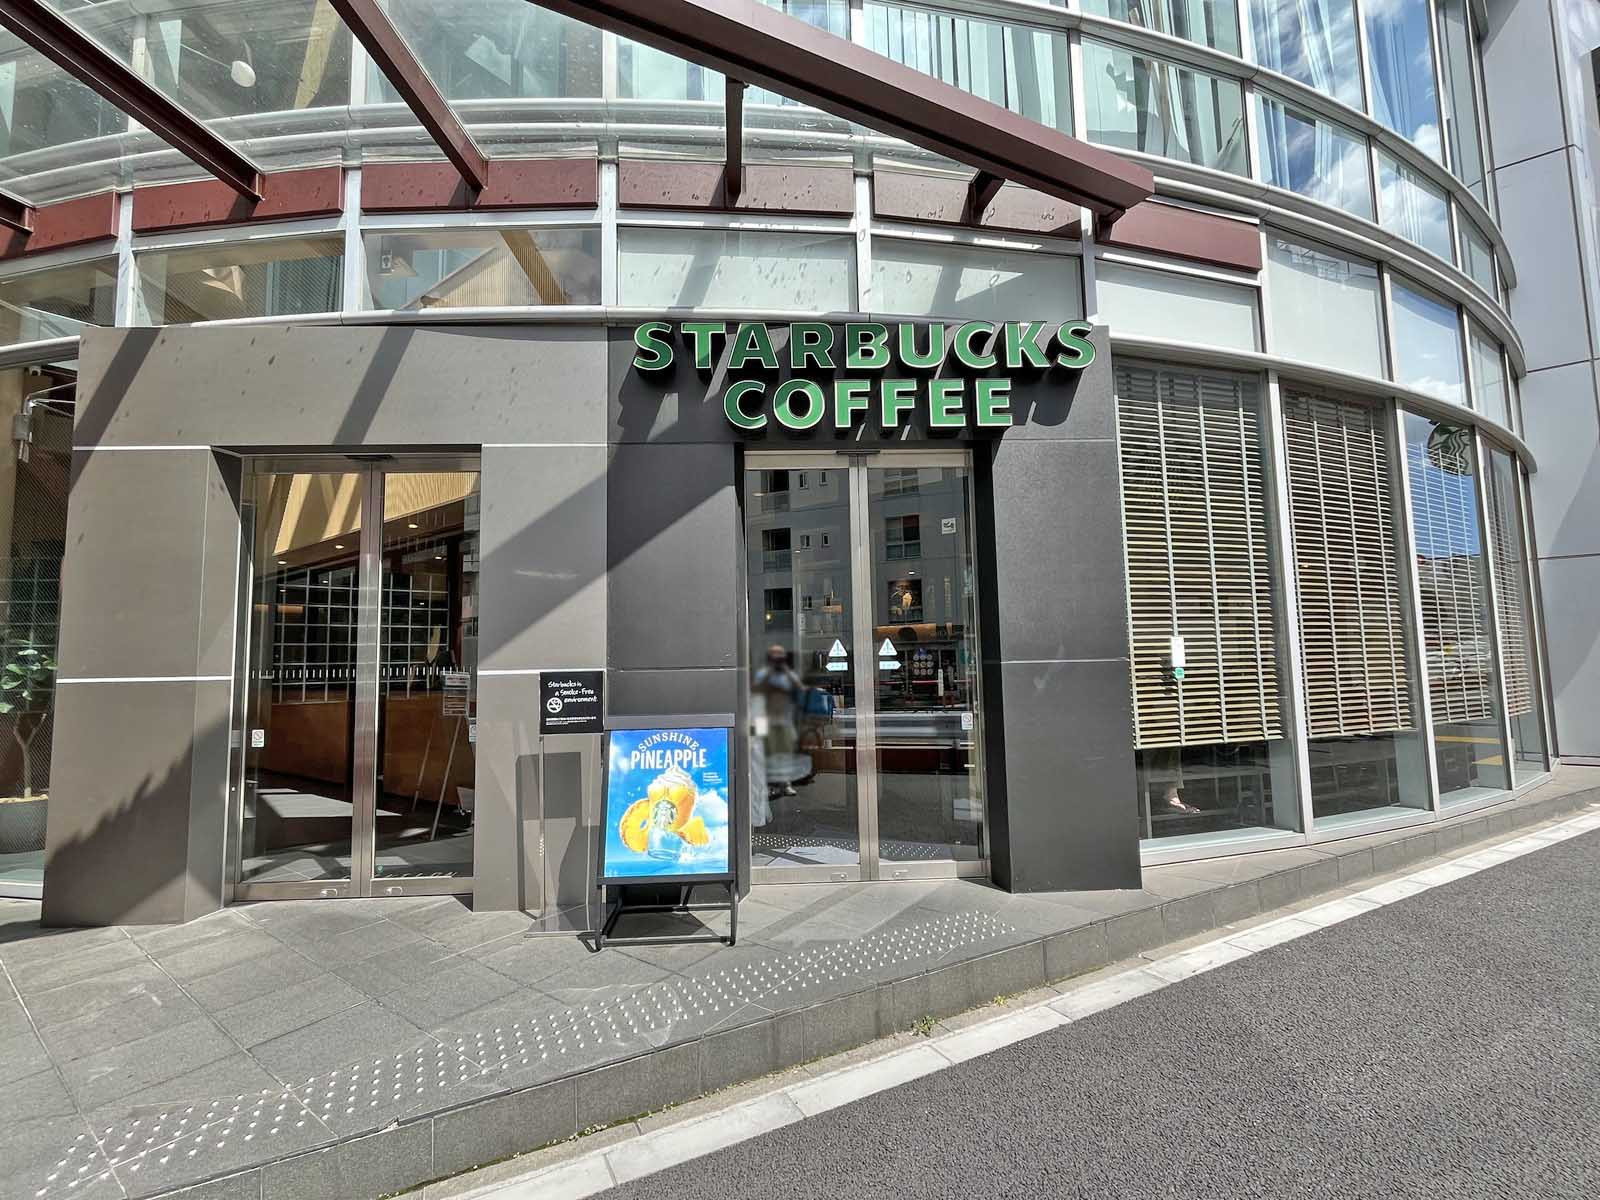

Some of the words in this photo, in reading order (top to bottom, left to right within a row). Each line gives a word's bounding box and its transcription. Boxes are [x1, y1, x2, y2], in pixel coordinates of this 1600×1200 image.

[633, 320, 1096, 371] STARBUCKS
[723, 377, 1013, 429] COFFEE
[547, 680, 576, 688] Starbucks
[638, 732, 700, 752] SUNSHINE
[631, 748, 707, 769] PINEAPPLE
